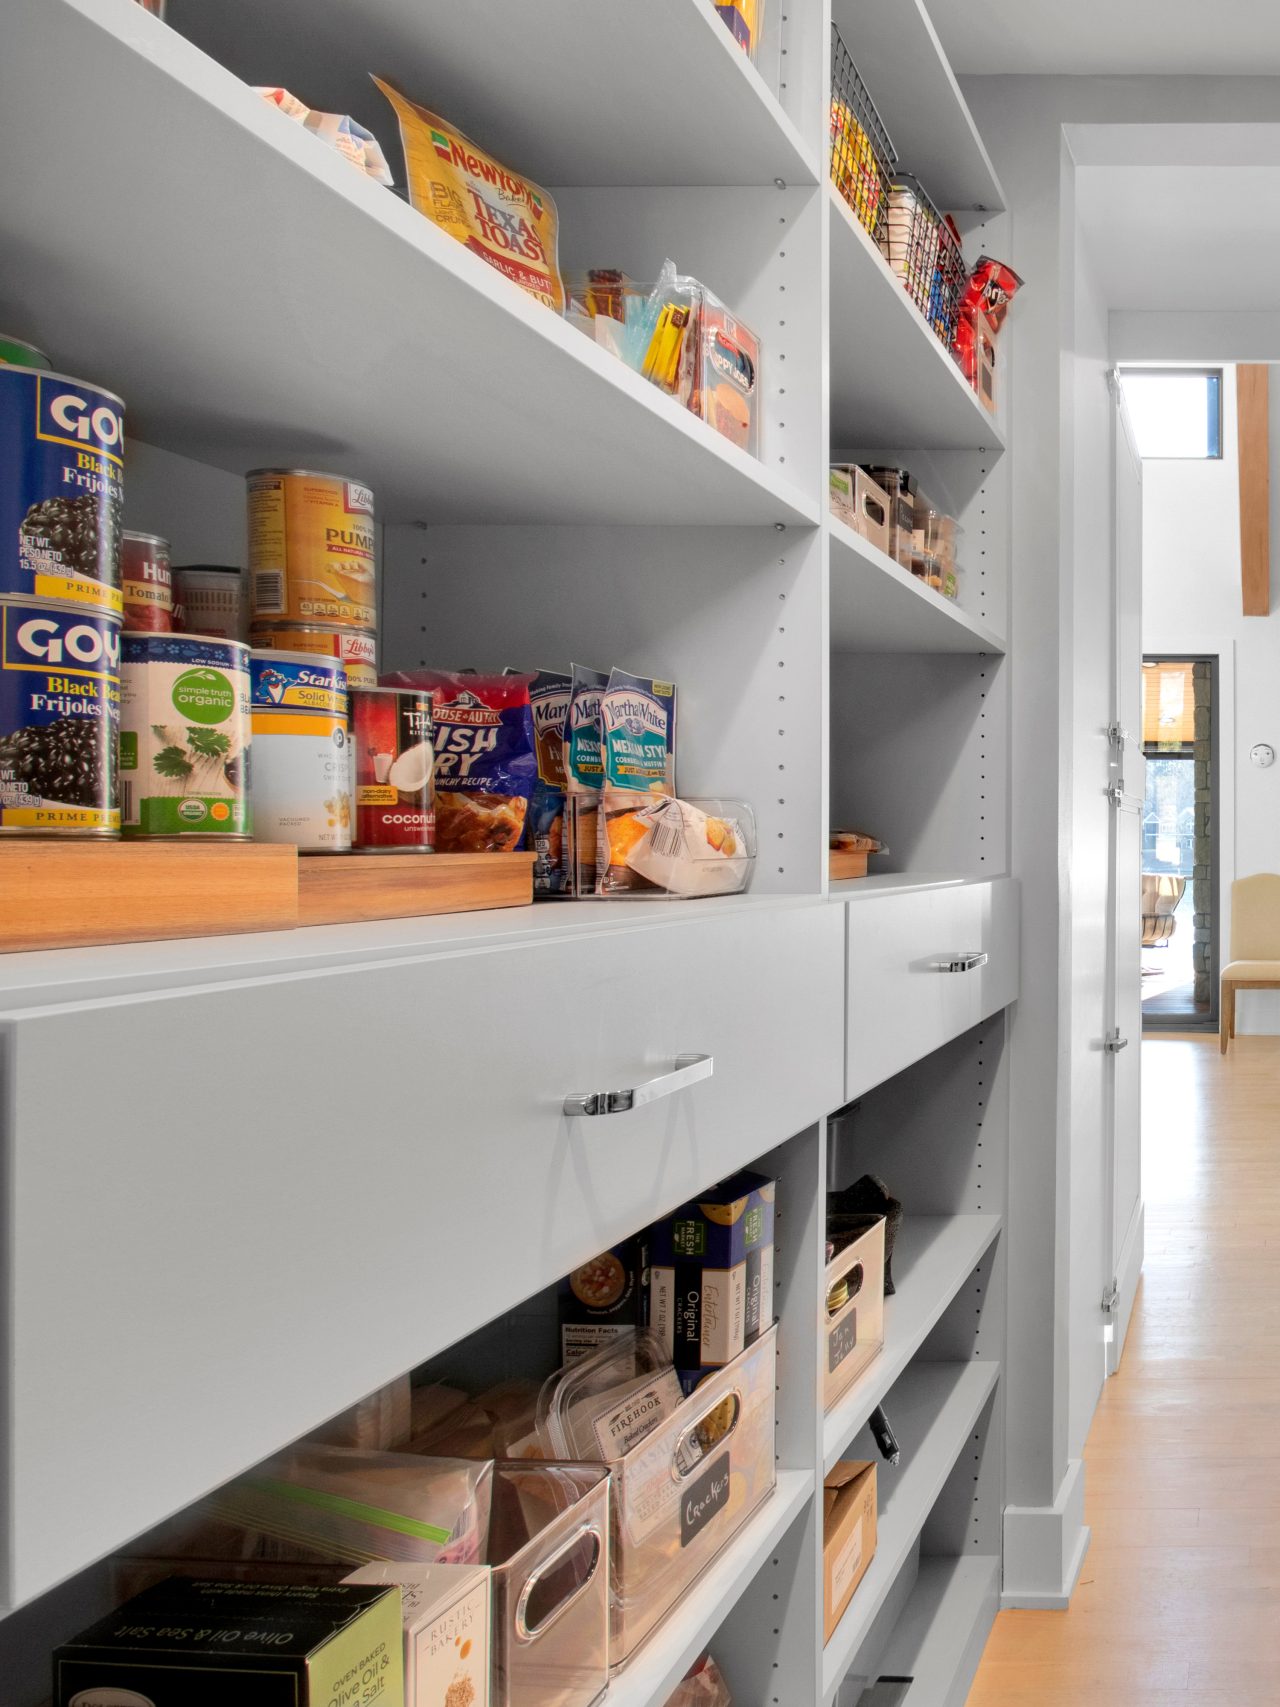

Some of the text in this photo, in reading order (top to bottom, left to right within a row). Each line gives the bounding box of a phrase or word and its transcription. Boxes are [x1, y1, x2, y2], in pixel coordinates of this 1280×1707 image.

[475, 214, 548, 266] TOAST
[482, 251, 516, 276] GARLIC
[518, 270, 527, 280] &
[77, 452, 116, 480] Black
[63, 466, 118, 497] Frijoles
[352, 488, 374, 505] Libb
[19, 535, 34, 545] NET
[19, 546, 62, 562] PESO NETO
[19, 559, 36, 570] 15.5
[17, 619, 120, 668] GOY
[47, 676, 99, 697] Black
[347, 675, 362, 683] 00%
[178, 686, 232, 697] simple truth
[178, 694, 232, 708] organic
[298, 690, 325, 702] Solid
[30, 694, 102, 716] Frijoles
[433, 708, 462, 721] OUSE
[434, 725, 499, 753] ISH
[433, 753, 483, 776] RY
[36, 812, 88, 821] PRIME
[685, 1220, 695, 1255] FRESH
[750, 1274, 760, 1326] Original
[683, 1290, 700, 1341] Original
[610, 1396, 662, 1437] FIREHOOK
[113, 1625, 155, 1639] Salt
[156, 1626, 193, 1640] Sea
[211, 1629, 242, 1642] Oil
[243, 1631, 294, 1645] Olive
[333, 1642, 386, 1692] OVEN BAKED
[362, 1662, 378, 1686] Oil
[380, 1654, 390, 1670] &
[362, 1675, 384, 1704] Salt
